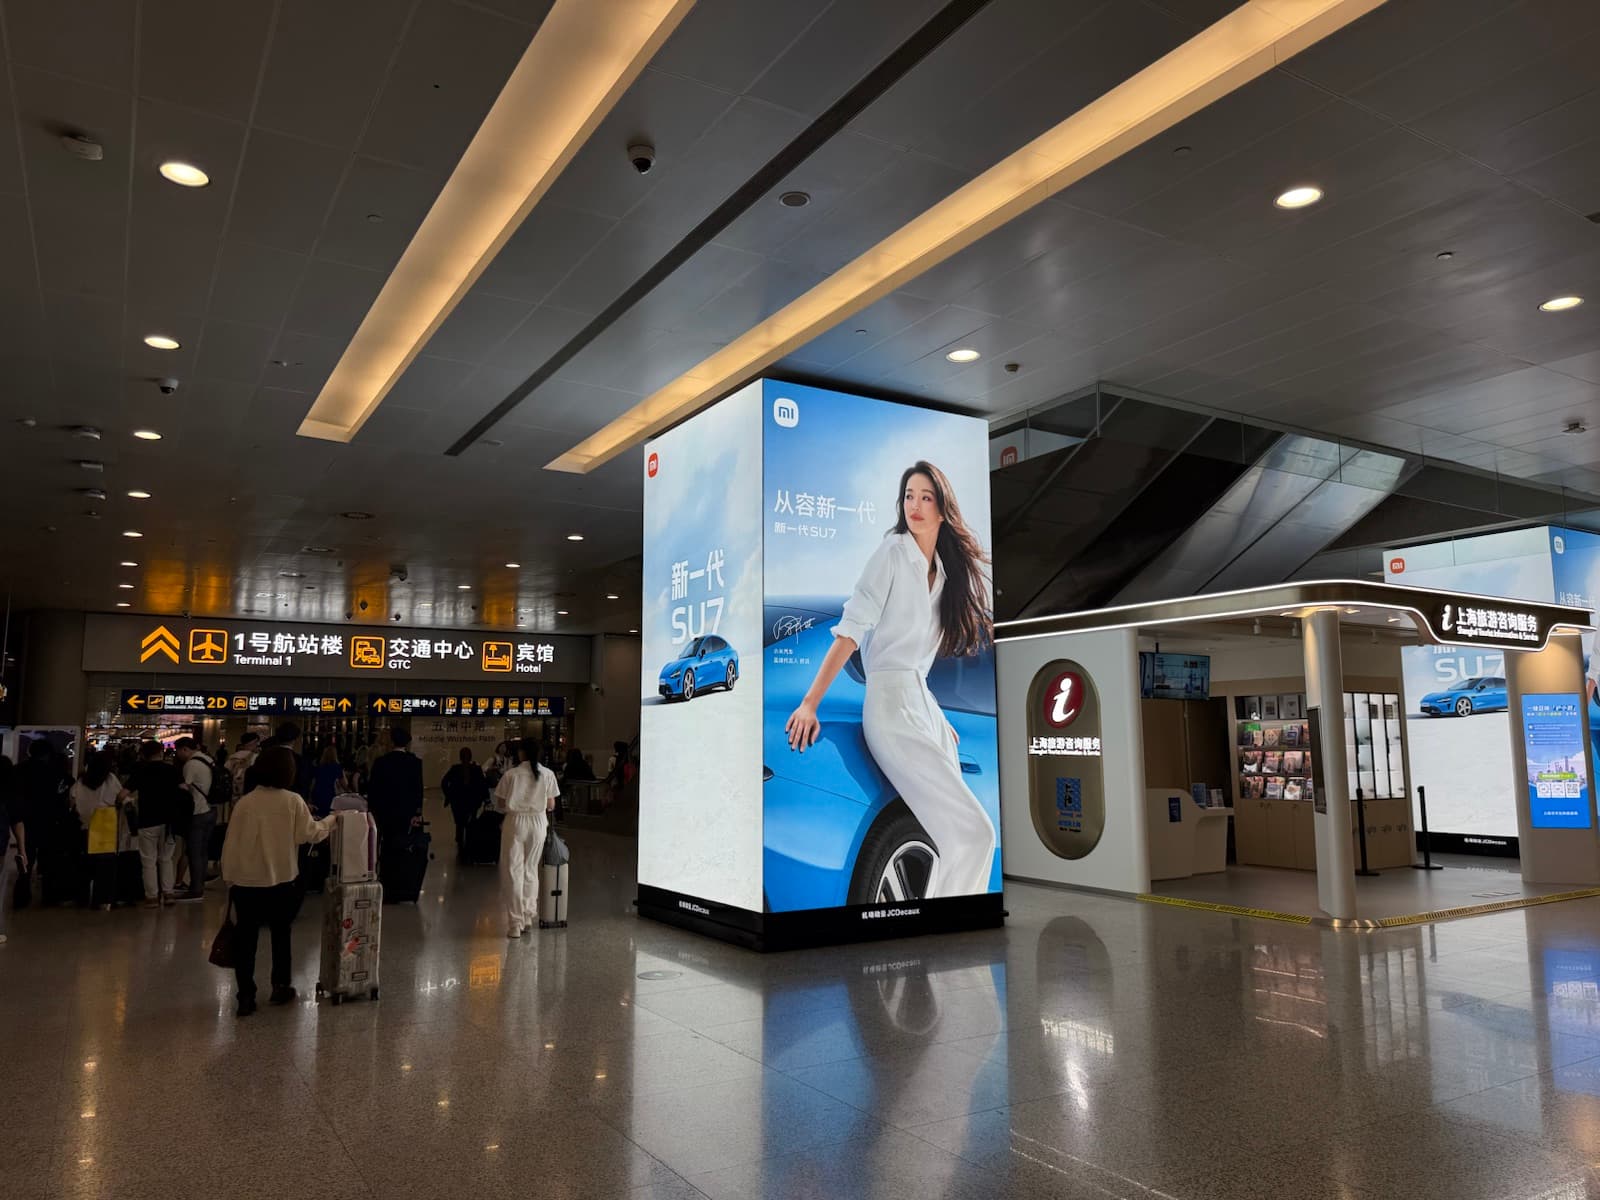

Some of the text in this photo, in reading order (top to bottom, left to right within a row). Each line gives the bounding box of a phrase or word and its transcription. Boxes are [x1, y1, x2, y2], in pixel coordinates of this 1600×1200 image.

[774, 489, 876, 525] 从容新一代
[774, 521, 837, 539] 新一代SU7
[671, 548, 725, 601] 新一代
[671, 597, 725, 645] SU7
[1456, 606, 1537, 633] 上海旅游咨询服务
[233, 632, 344, 656] 1号航站楼
[388, 638, 474, 659] 交通中心
[233, 654, 292, 666] Terminal 1
[515, 643, 555, 663] 宾馆
[388, 659, 411, 670] GTC
[515, 663, 541, 673] Hotel
[1434, 655, 1505, 682] SU7
[164, 695, 228, 709] 国内到达 2D
[249, 696, 277, 706] 出租车
[293, 697, 321, 707] 网约车
[402, 699, 437, 708] 交通中心
[1029, 736, 1101, 751] 上海旅游咨询服务
[887, 908, 921, 918] JCDecaux
